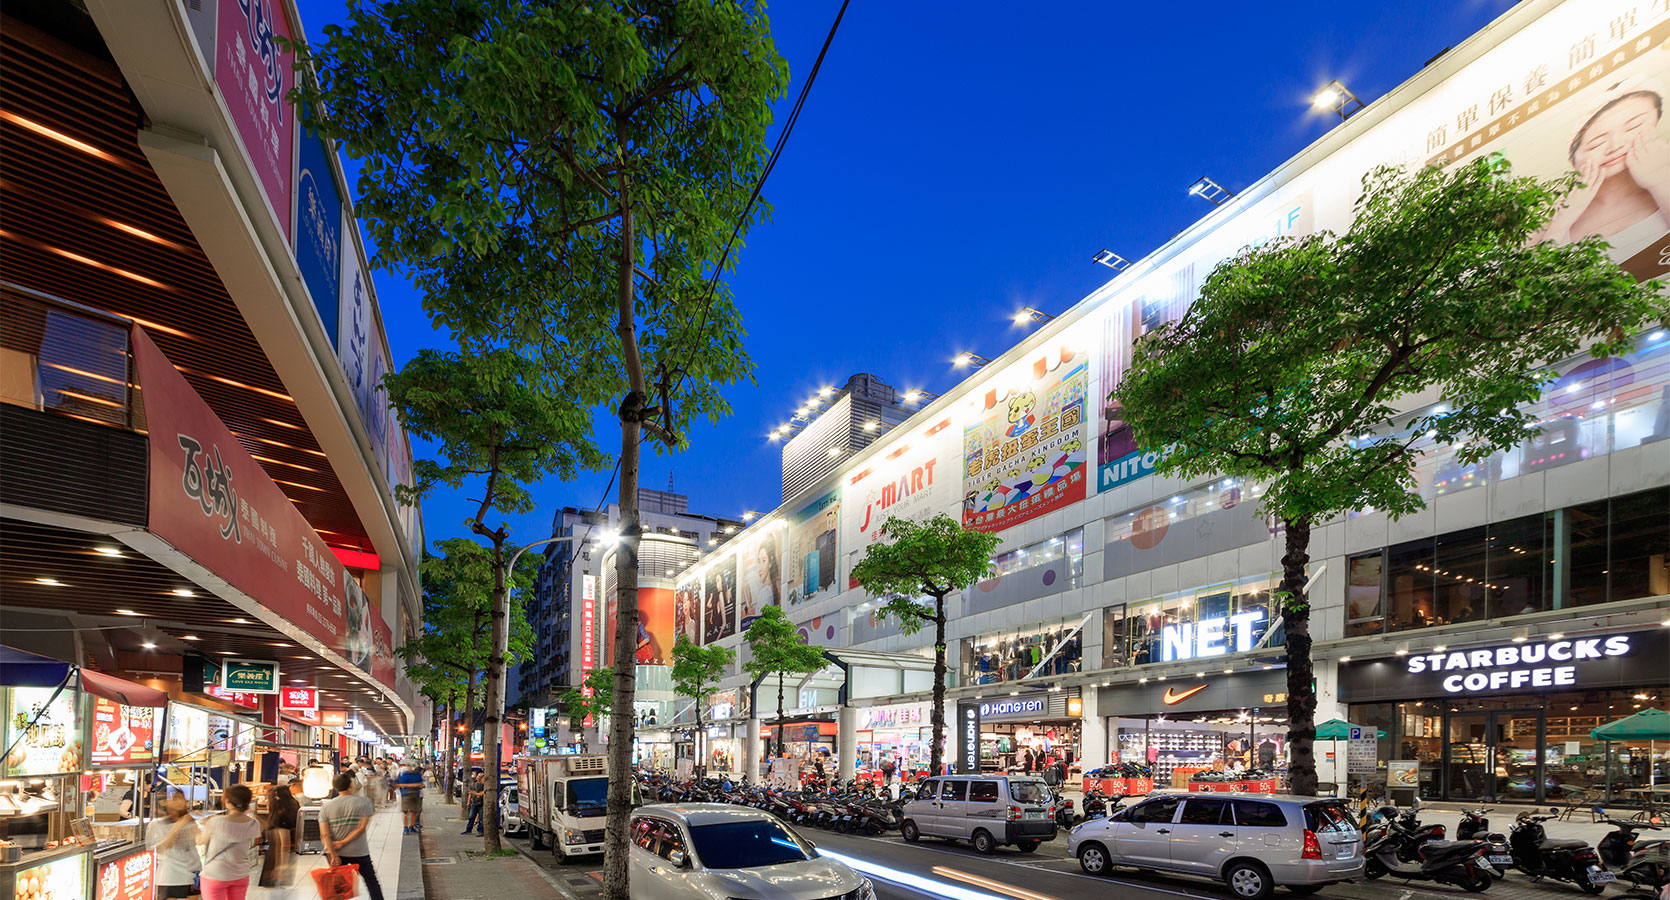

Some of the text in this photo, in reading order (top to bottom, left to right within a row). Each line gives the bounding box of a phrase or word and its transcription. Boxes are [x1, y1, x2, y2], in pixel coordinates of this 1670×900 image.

[1427, 63, 1549, 154] 簡單保養
[967, 404, 1081, 477] 老虎扭蛋王國
[968, 430, 1080, 488] TIGER GACHA KINGDOM
[913, 486, 934, 504] MART
[240, 497, 277, 548] 泰國料理
[1163, 611, 1263, 661] NET
[1408, 636, 1630, 673] STARBUCKS
[1443, 666, 1576, 692] COFFEE
[1352, 729, 1360, 739] P
[1113, 780, 1124, 789] 50%
[1260, 783, 1271, 791] 50%
